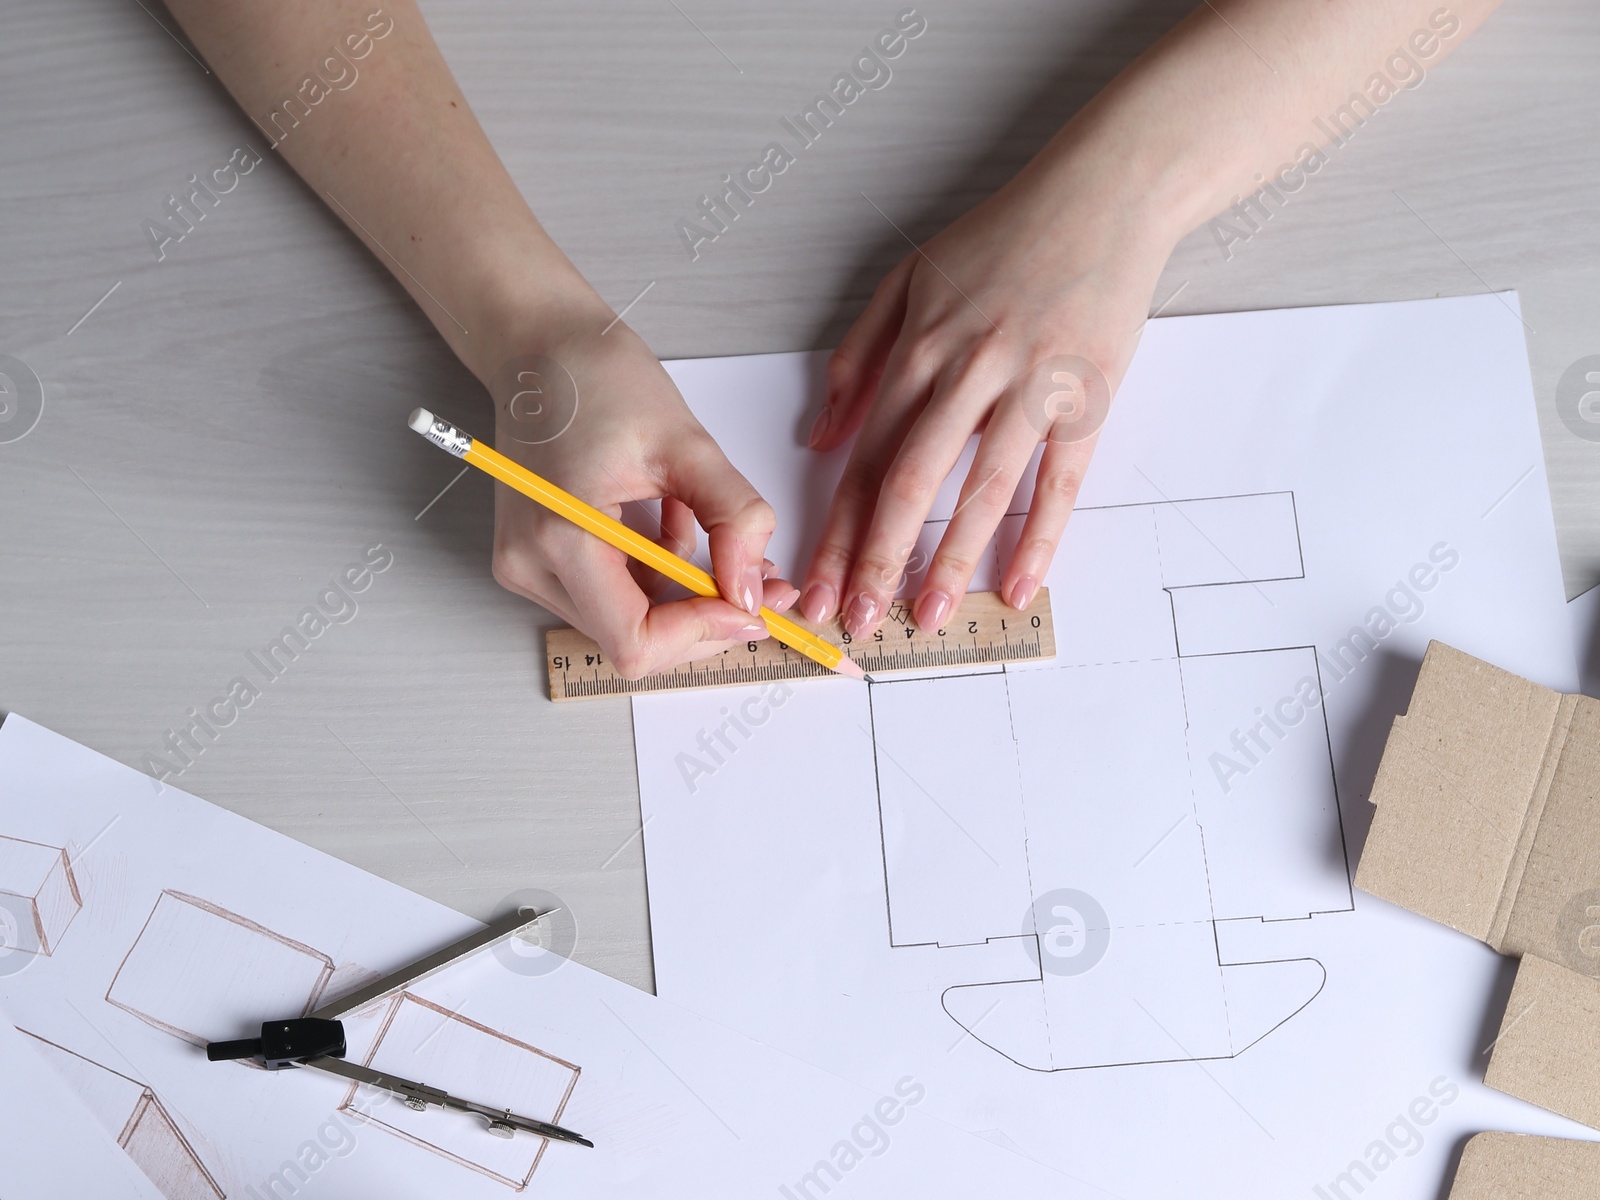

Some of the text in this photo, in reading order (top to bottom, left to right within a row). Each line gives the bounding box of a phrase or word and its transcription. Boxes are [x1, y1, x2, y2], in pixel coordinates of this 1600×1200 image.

[967, 621, 978, 634] 2
[1000, 618, 1008, 632] 1
[1030, 615, 1041, 629] 0
[904, 627, 915, 639] 4
[553, 655, 571, 671] 15
[584, 653, 603, 667] 14
